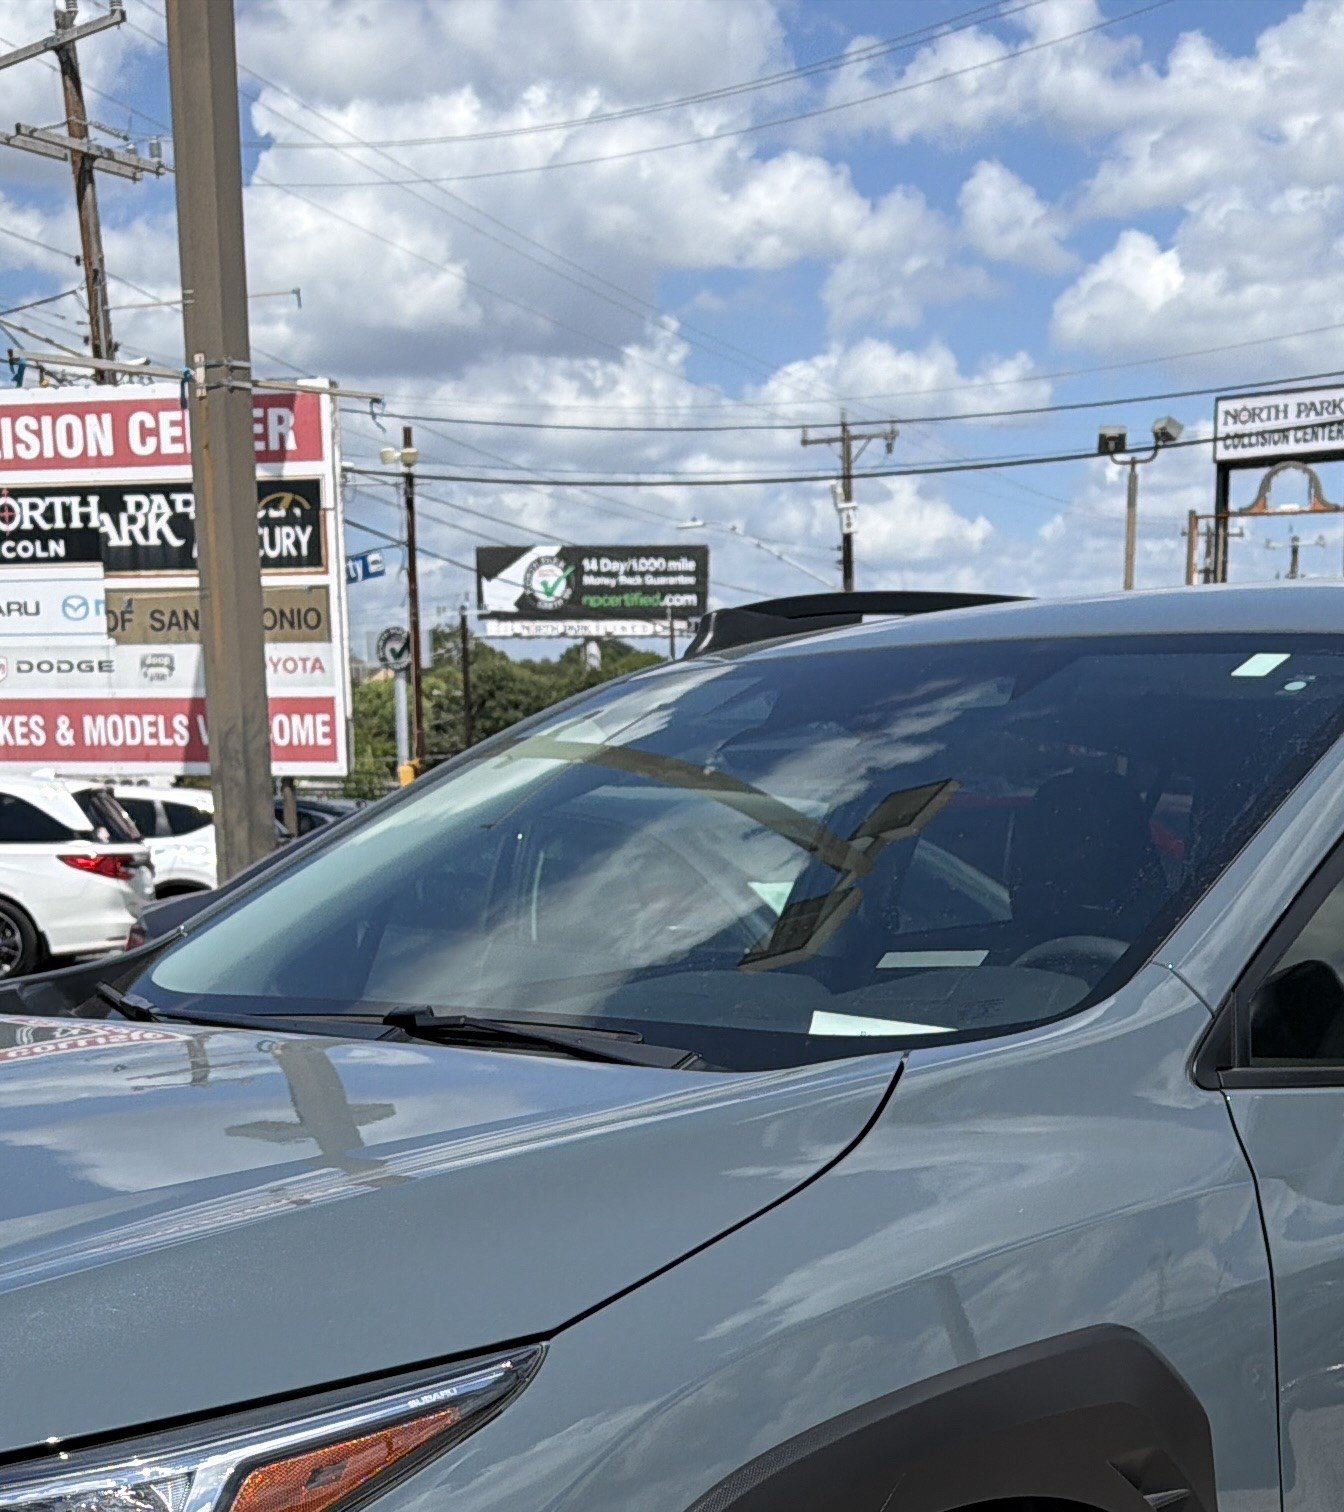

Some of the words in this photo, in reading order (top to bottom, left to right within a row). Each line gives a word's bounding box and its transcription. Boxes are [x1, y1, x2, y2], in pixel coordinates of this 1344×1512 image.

[1223, 403, 1289, 427] NORTH
[128, 407, 298, 457] CEER
[1223, 430, 1290, 451] COLLISION
[1294, 423, 1344, 444] CENTER
[149, 608, 200, 633] SAN
[262, 606, 322, 632] ONIO
[16, 659, 115, 675] DODGE
[268, 656, 326, 675] YOTA
[56, 715, 76, 746] &
[82, 713, 191, 747] MODELS
